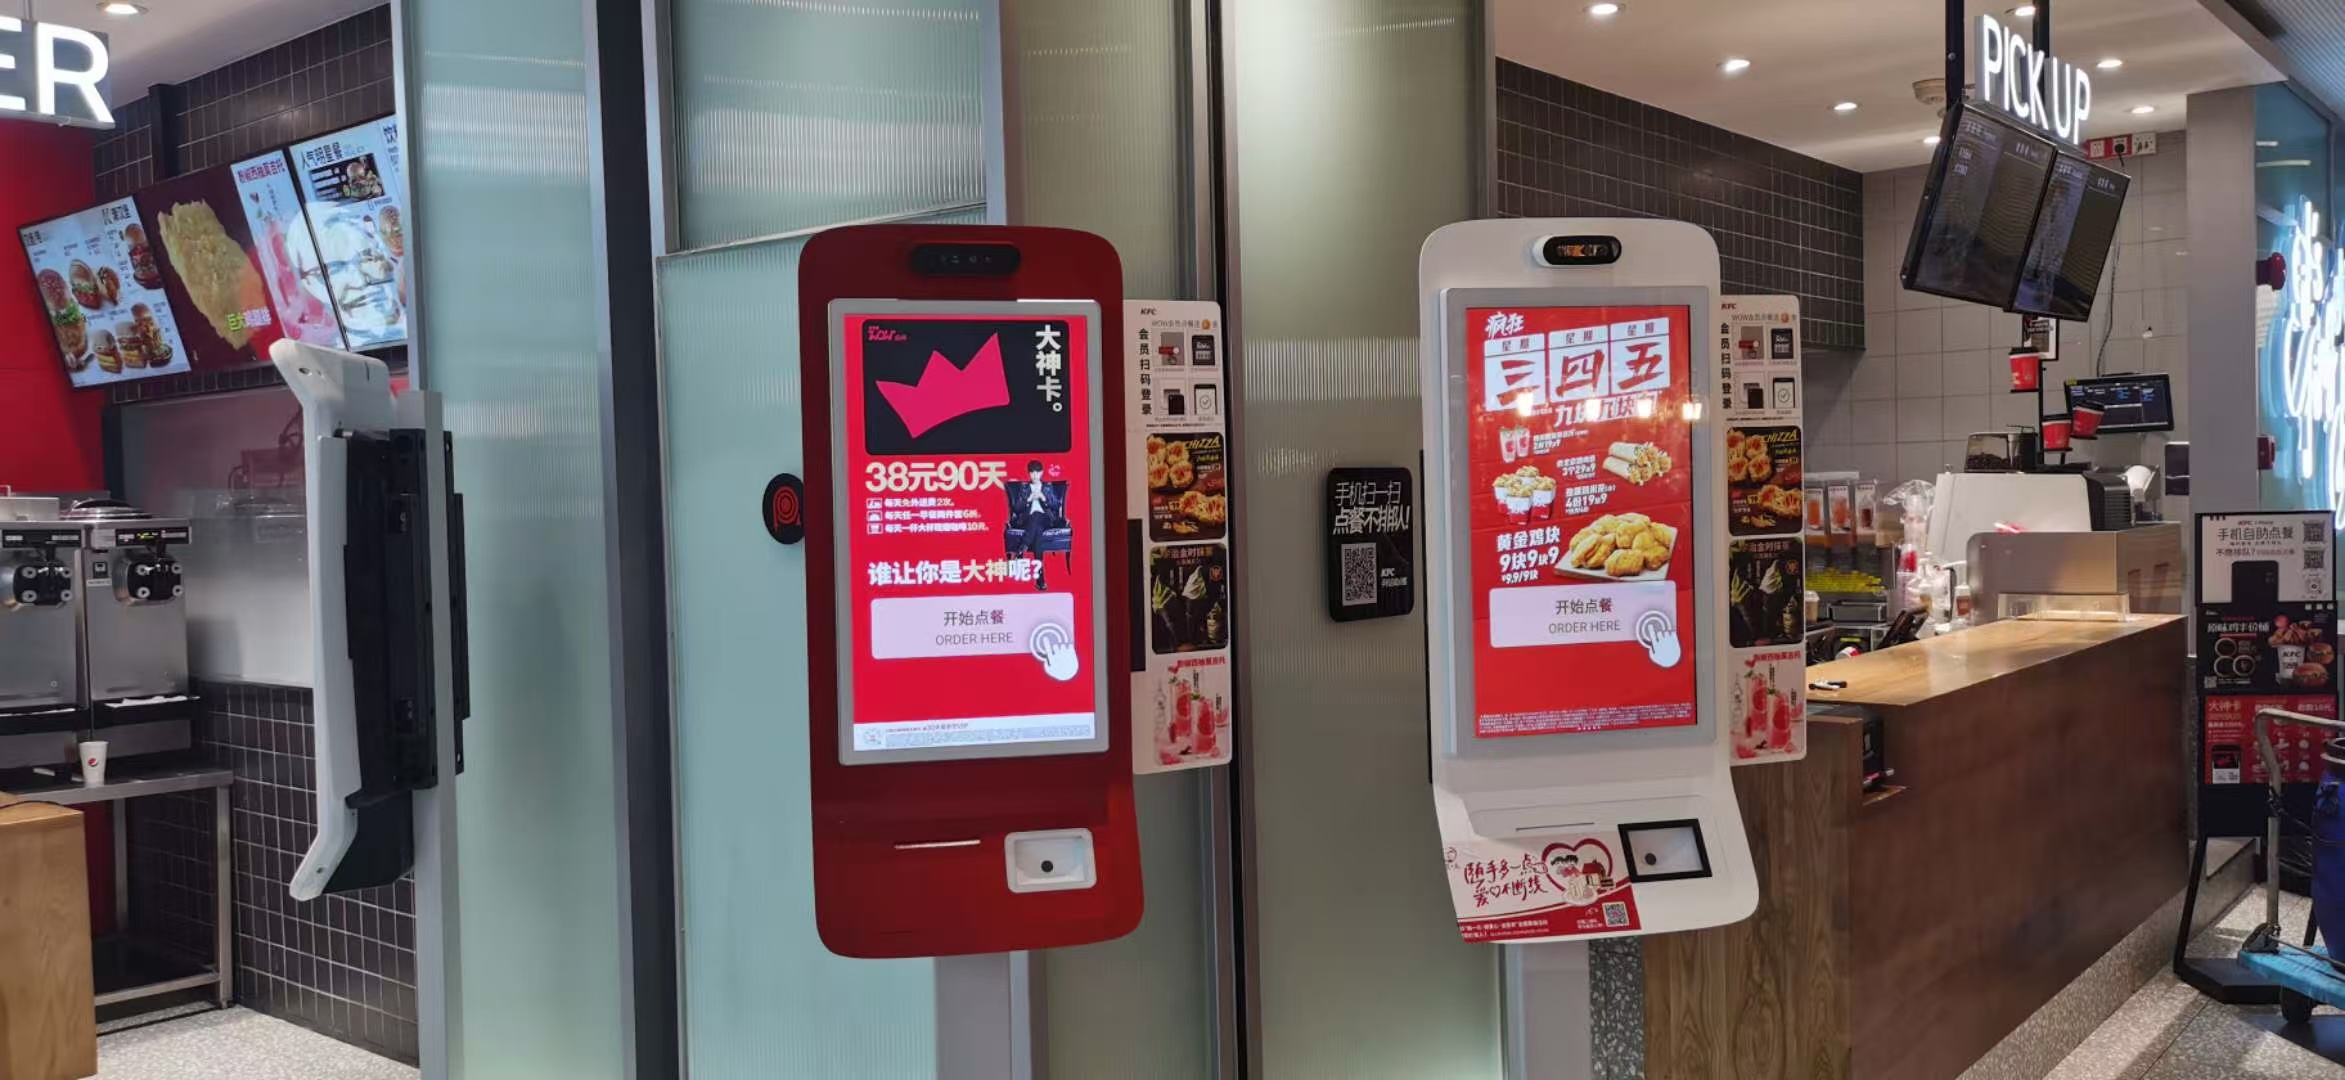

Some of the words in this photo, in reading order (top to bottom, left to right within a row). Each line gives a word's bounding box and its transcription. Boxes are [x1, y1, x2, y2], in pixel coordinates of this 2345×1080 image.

[1983, 14, 2049, 131] PICK
[2053, 56, 2092, 145] UP
[1484, 312, 1525, 338] 疯狂
[1035, 324, 1062, 412] 大神卡。
[1139, 328, 1152, 415] 会员扫码登录
[1496, 359, 1540, 406] 三
[1555, 349, 1605, 397] 四
[1617, 342, 1665, 389] 五
[1720, 322, 1732, 409] 会员扫码登录
[1335, 480, 1402, 506] 手机扫一扫
[1497, 526, 1560, 552] 黄金鸡块
[2217, 526, 2294, 541] 手机自助点餐
[1499, 546, 1560, 573] 9块9块9
[868, 560, 1042, 586] 谁让你是大神呢?
[943, 609, 1005, 627] 开始点餐
[1555, 598, 1612, 615] 开始点餐
[935, 634, 977, 646] ORDER
[981, 632, 1013, 645] HERE
[1548, 622, 1587, 634] ORDER
[1591, 620, 1621, 632] HERE
